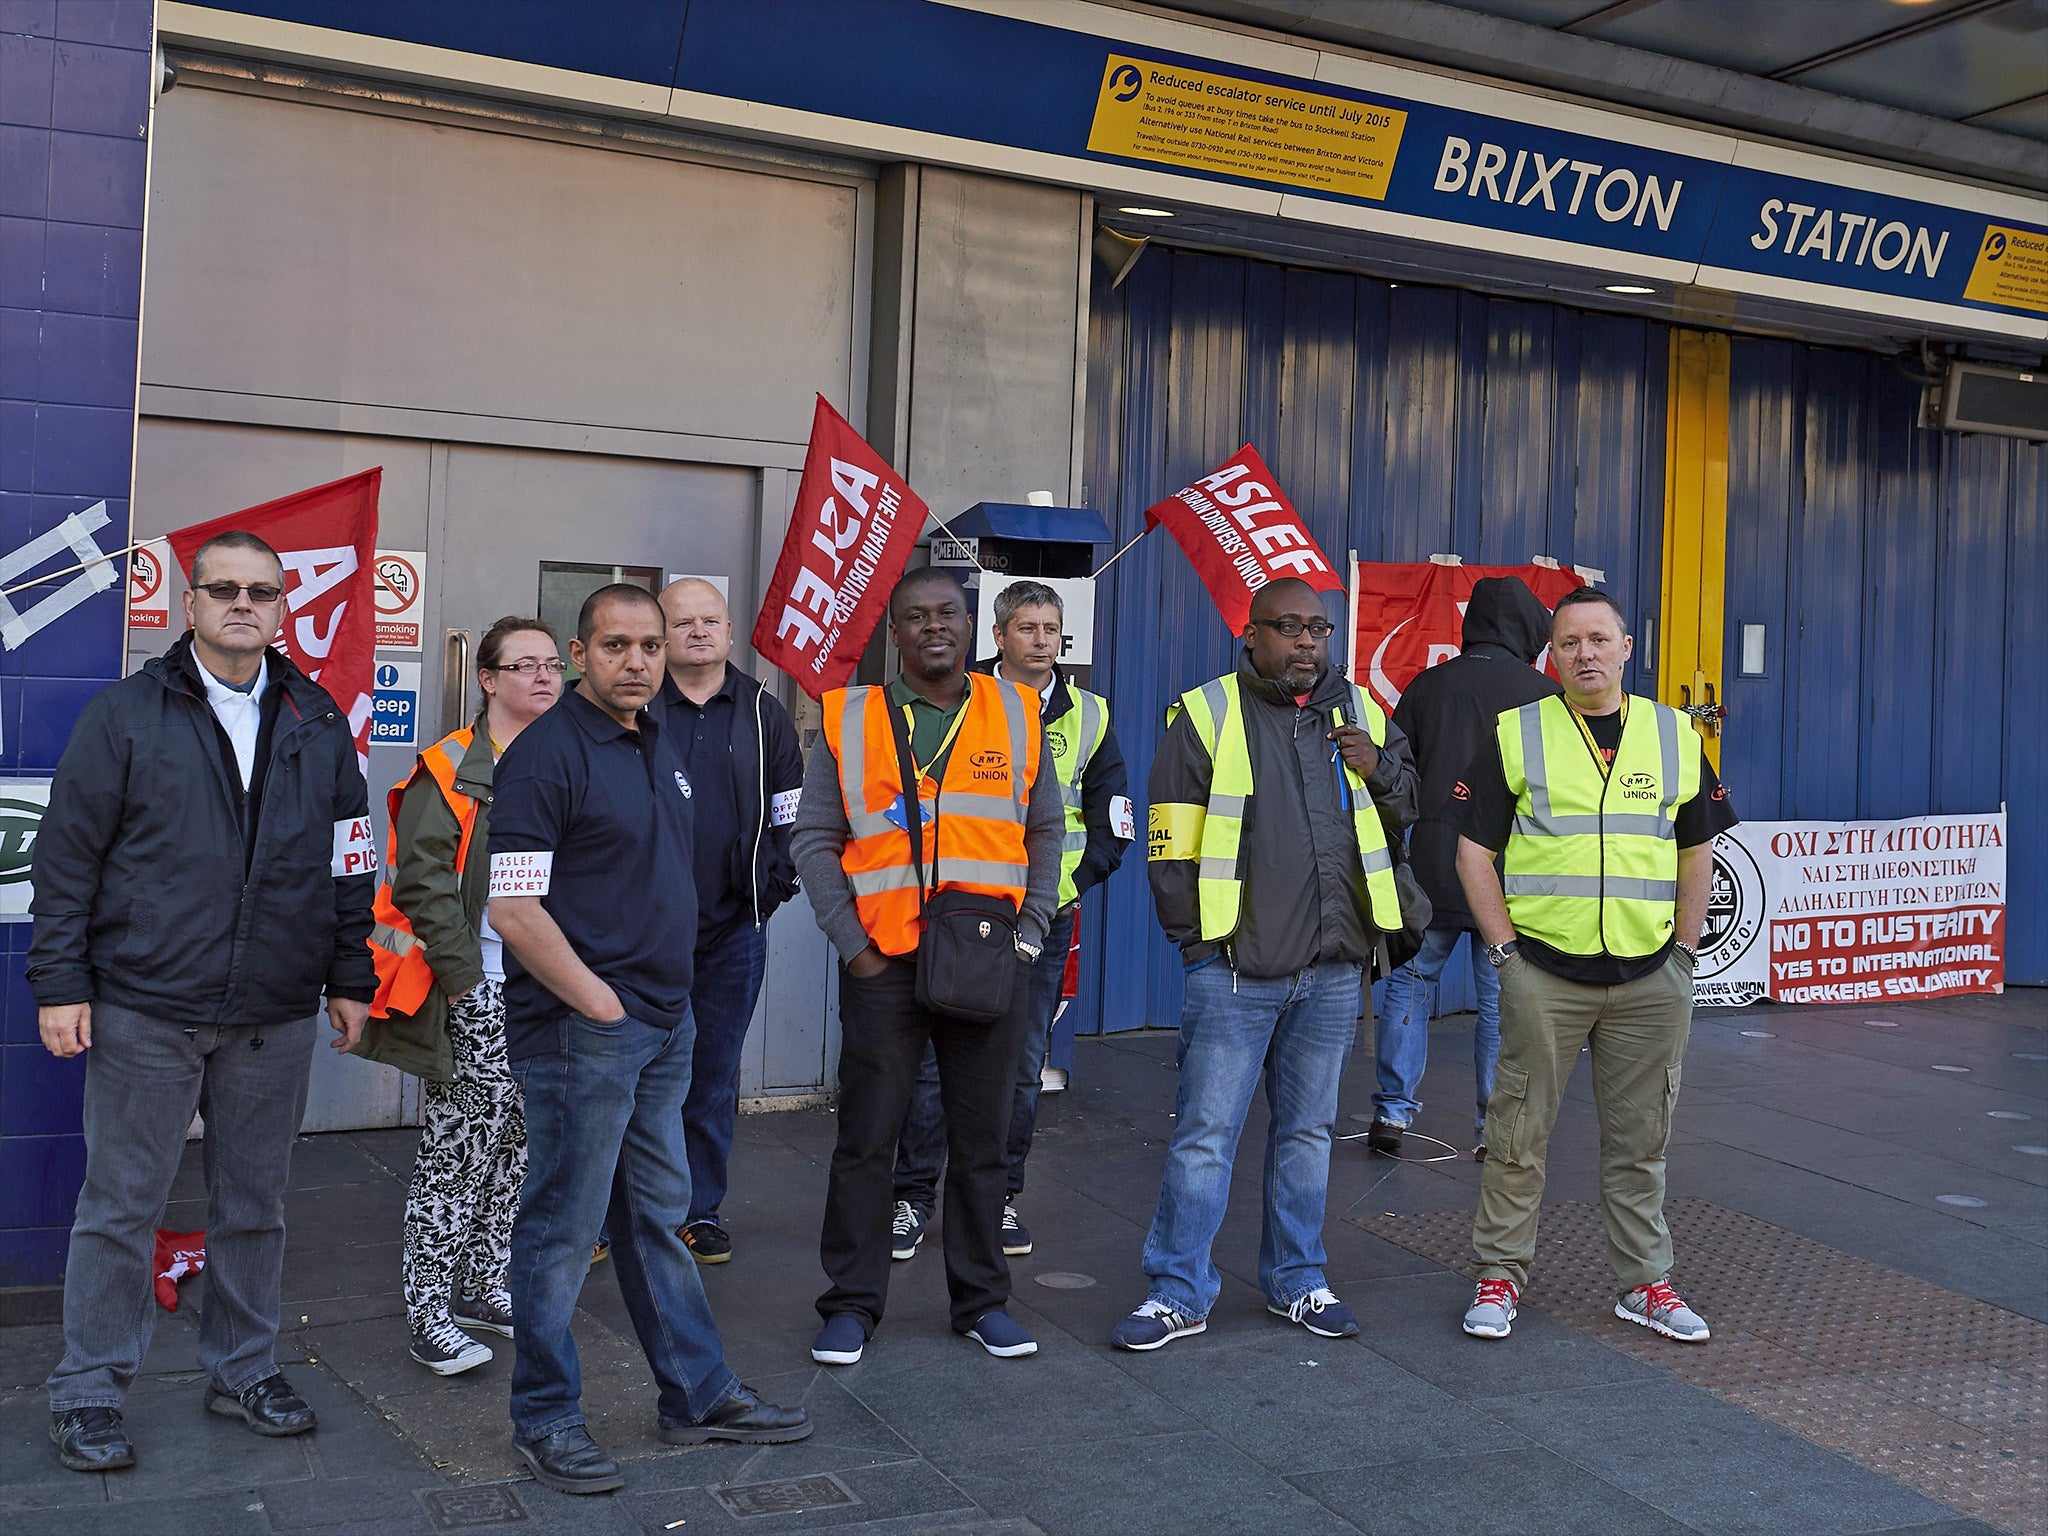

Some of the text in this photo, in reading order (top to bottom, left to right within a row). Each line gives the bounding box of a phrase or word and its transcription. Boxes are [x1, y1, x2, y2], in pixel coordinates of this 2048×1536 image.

[1150, 70, 1391, 128] Reduced escalator service until July 2015
[1146, 92, 1376, 143] To avoid queues at busy times take the bus to Stockwell Station
[1197, 112, 1211, 122] from
[1212, 116, 1227, 125] stop
[1239, 121, 1261, 131] Brixton
[1139, 116, 1384, 168] Alternatively use National Rail services between Brixton and Victoria
[1136, 131, 1165, 144] Travelling
[1166, 137, 1190, 148] outside
[1224, 147, 1236, 156] and
[1267, 155, 1279, 163] will
[1280, 157, 1296, 166] mean
[1296, 160, 1308, 169] you
[1308, 163, 1324, 172] avoid
[1325, 165, 1335, 174] the
[1336, 167, 1357, 177] busiest
[1357, 170, 1374, 180] times
[1156, 147, 1187, 158] information
[1433, 135, 1950, 279] BRIXTON STATION
[2011, 235, 2045, 251] Reduced
[1194, 463, 1329, 575] ASLEF
[375, 624, 416, 636] smoking
[370, 720, 409, 738] lear
[978, 756, 1002, 764] RMT
[973, 770, 1008, 781] UNION
[1627, 777, 1650, 785] RMT
[1623, 790, 1657, 800] UNION
[1771, 823, 2004, 858] ΟΧΙ ΣΤΗ ΛΙΤΟΤΗΤΑ
[1148, 844, 1166, 857] ET
[499, 856, 534, 866] ASLEF
[1802, 865, 1830, 884] ΝΑΙ
[1835, 863, 1869, 882] ΣΤΗ
[490, 881, 544, 892] PICKET
[1892, 886, 1930, 905] ΤΩΝ
[1773, 909, 2002, 952] NO TO AUSTERITY
[1771, 944, 2000, 980] YES TO INTERNATIONAL
[1730, 981, 1766, 995] UNION
[1778, 969, 1993, 1002] WORKERS SOLIDARITY
